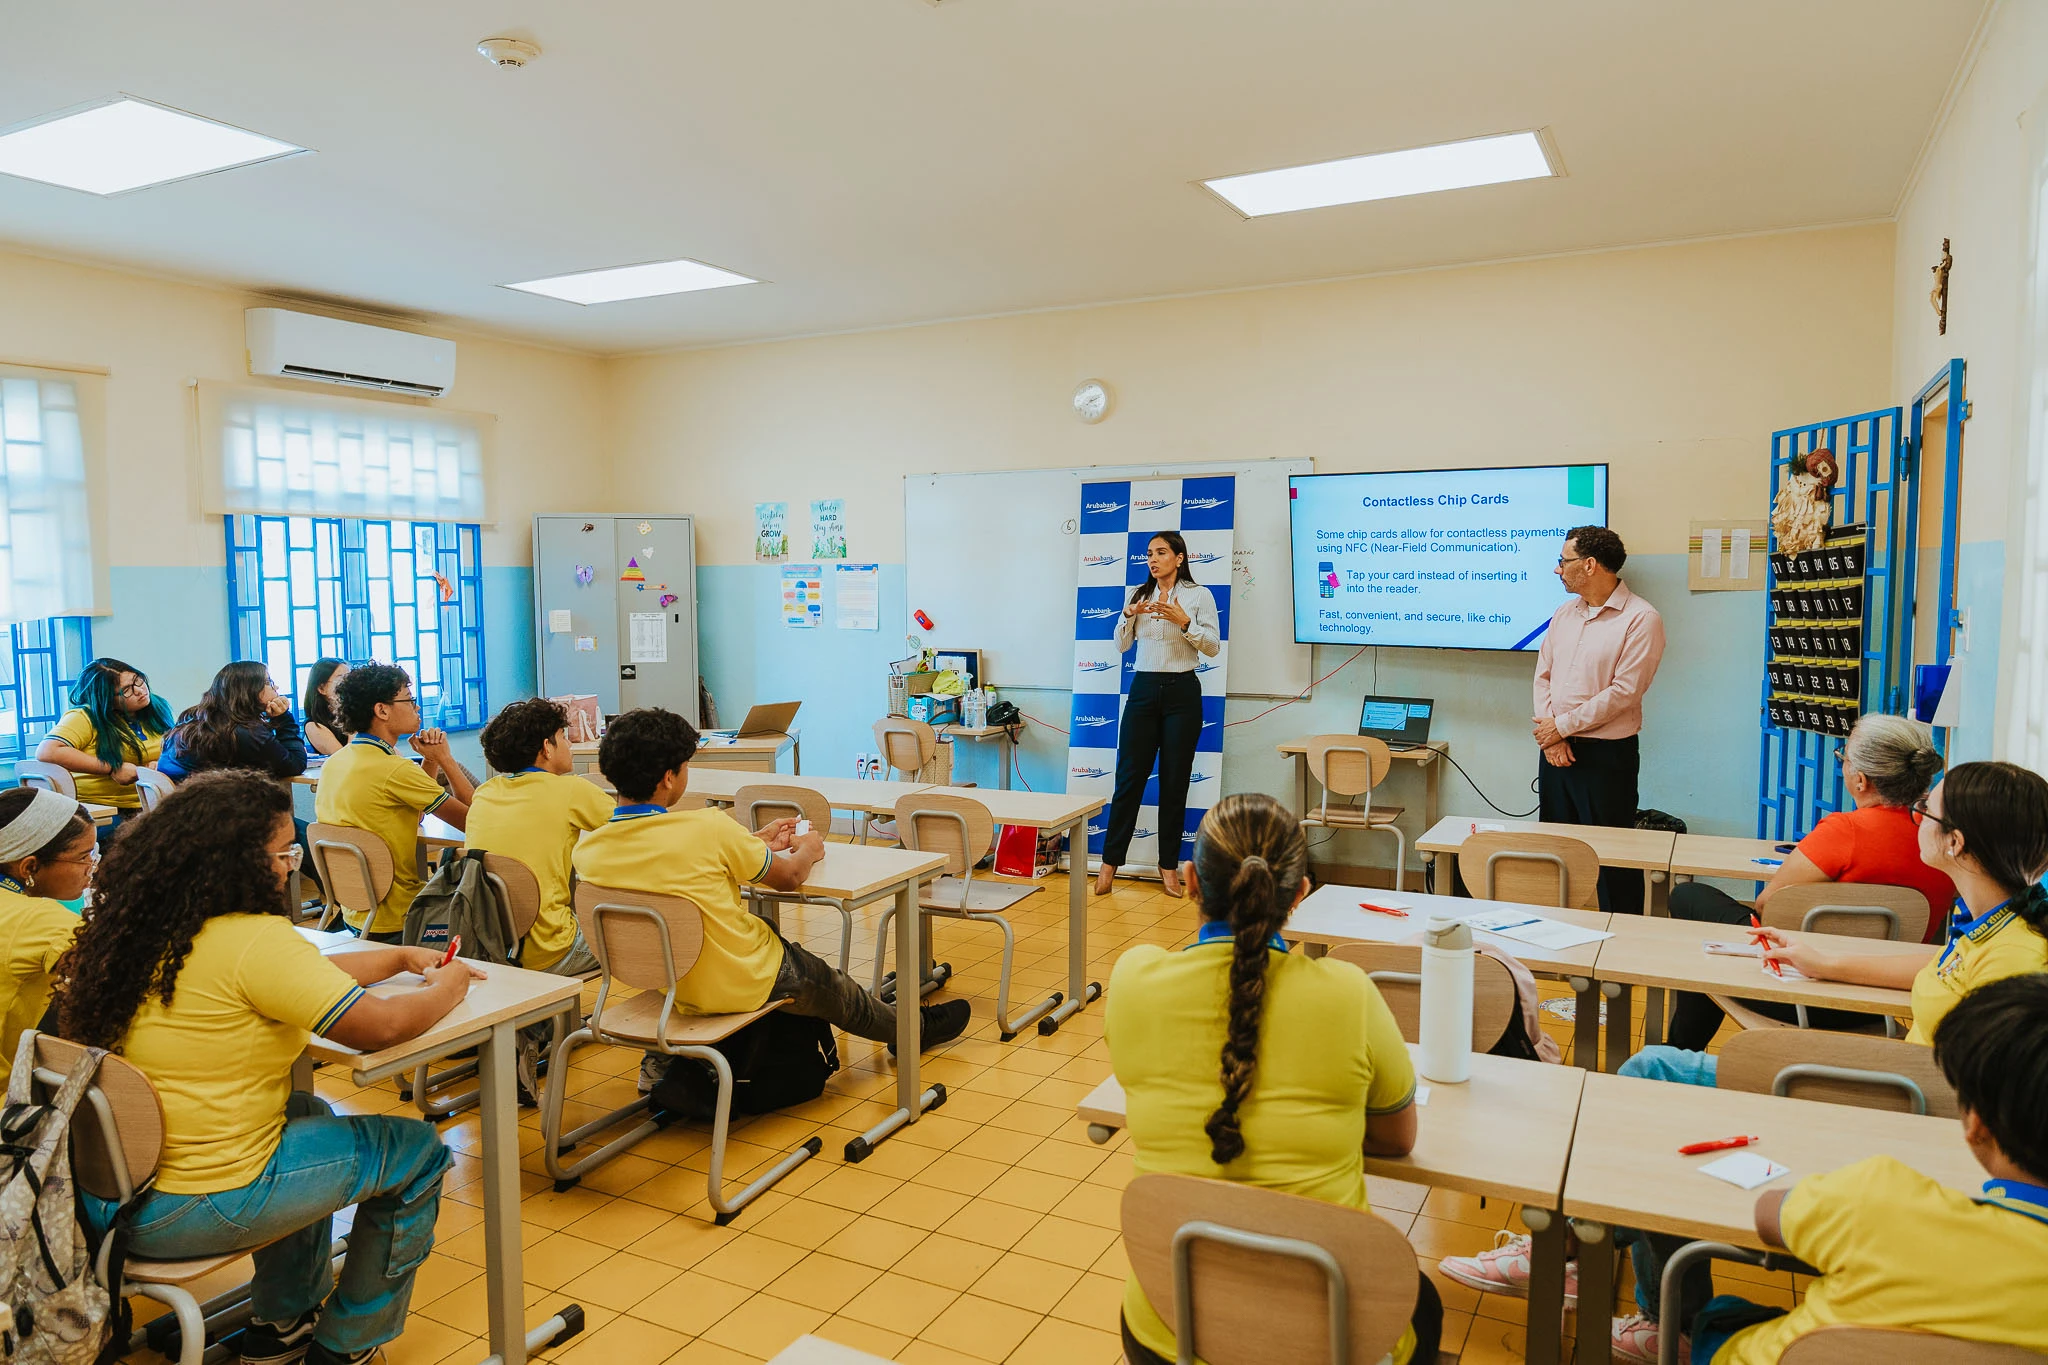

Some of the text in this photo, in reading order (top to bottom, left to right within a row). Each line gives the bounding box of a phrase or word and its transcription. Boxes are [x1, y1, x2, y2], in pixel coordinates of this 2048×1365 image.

[1086, 501, 1118, 509] Arubabank
[1134, 499, 1166, 507] Arubabank
[1183, 497, 1218, 505] Arubabank
[1362, 493, 1509, 507] Contactless Chip Cards
[820, 514, 837, 522] HARD
[761, 529, 782, 538] GROW
[1316, 527, 1566, 540] Some chip cards allow for contactless payments
[1316, 542, 1521, 555] using NFC (Near-Field Communication).
[1772, 556, 1855, 574] 01 02 03 04 05 06
[1346, 569, 1528, 583] Tap your card instead of inserting it
[1346, 583, 1421, 594] into the reader.
[1772, 597, 1853, 612] 07 08 09 10 11 12
[1319, 609, 1511, 625] Fast, convenient, and secure, like chip
[1319, 622, 1374, 635] technology.
[1771, 636, 1851, 651] 13 14 15 16 17 18
[1769, 672, 1849, 692] 19 20 21 22 23 24
[1769, 708, 1849, 731] 25 26 27 28 29 30
